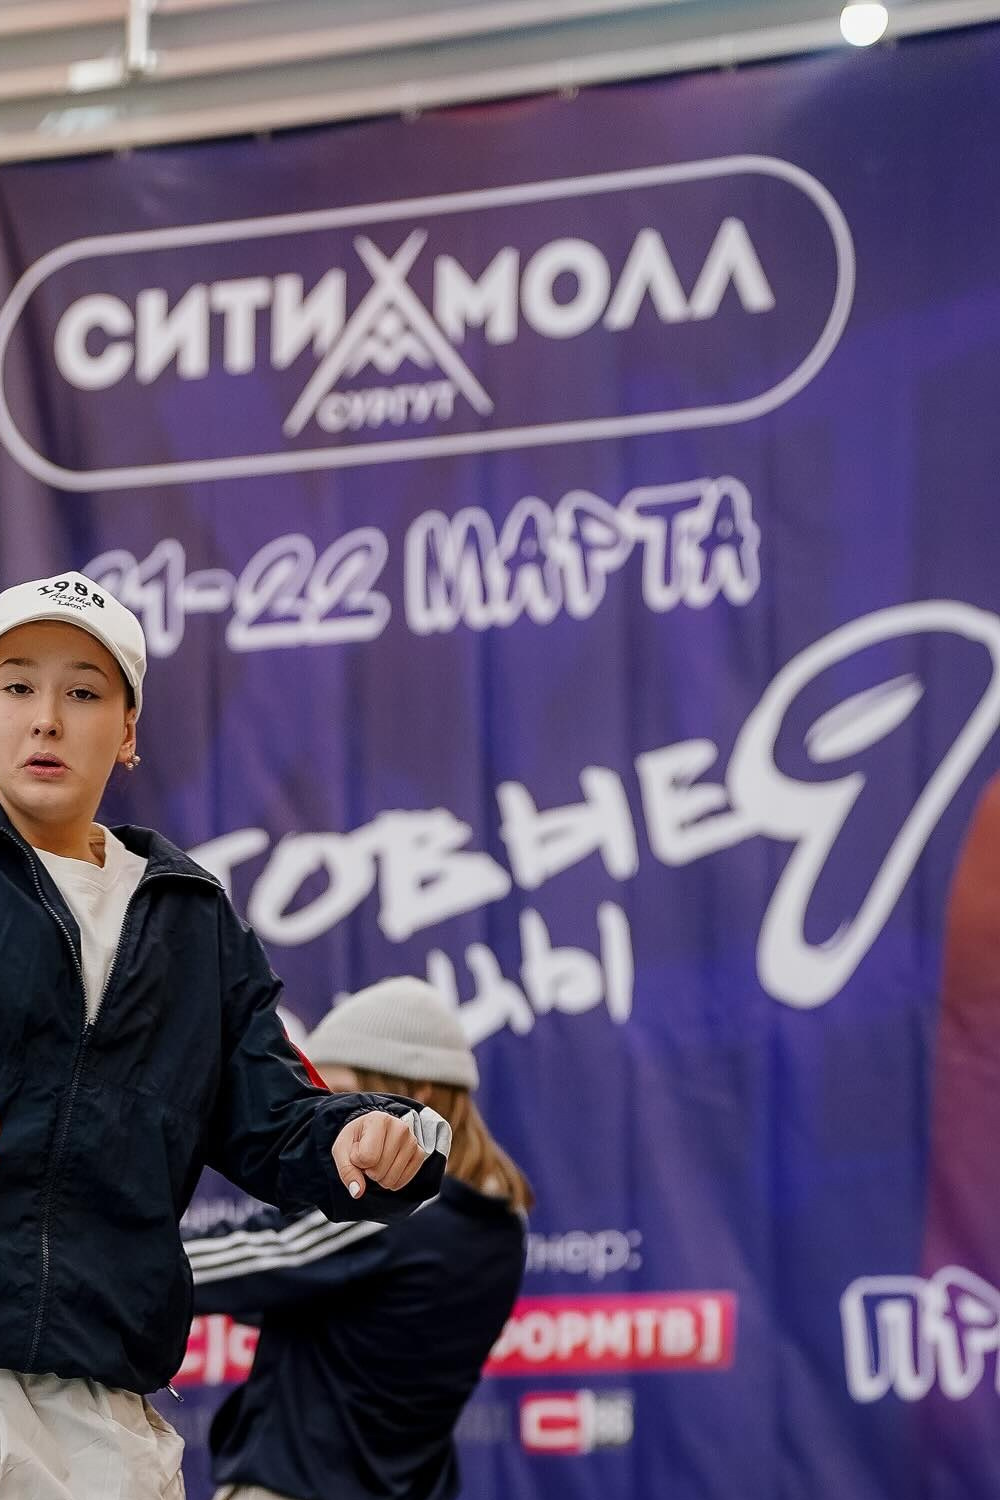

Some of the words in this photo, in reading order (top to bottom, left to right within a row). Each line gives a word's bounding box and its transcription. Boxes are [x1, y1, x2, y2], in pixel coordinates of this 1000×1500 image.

[54, 268, 347, 391] СИТИ
[434, 215, 777, 346] МОЛЛ
[404, 476, 760, 637] МАРТА
[839, 1265, 1000, 1404] ПР
